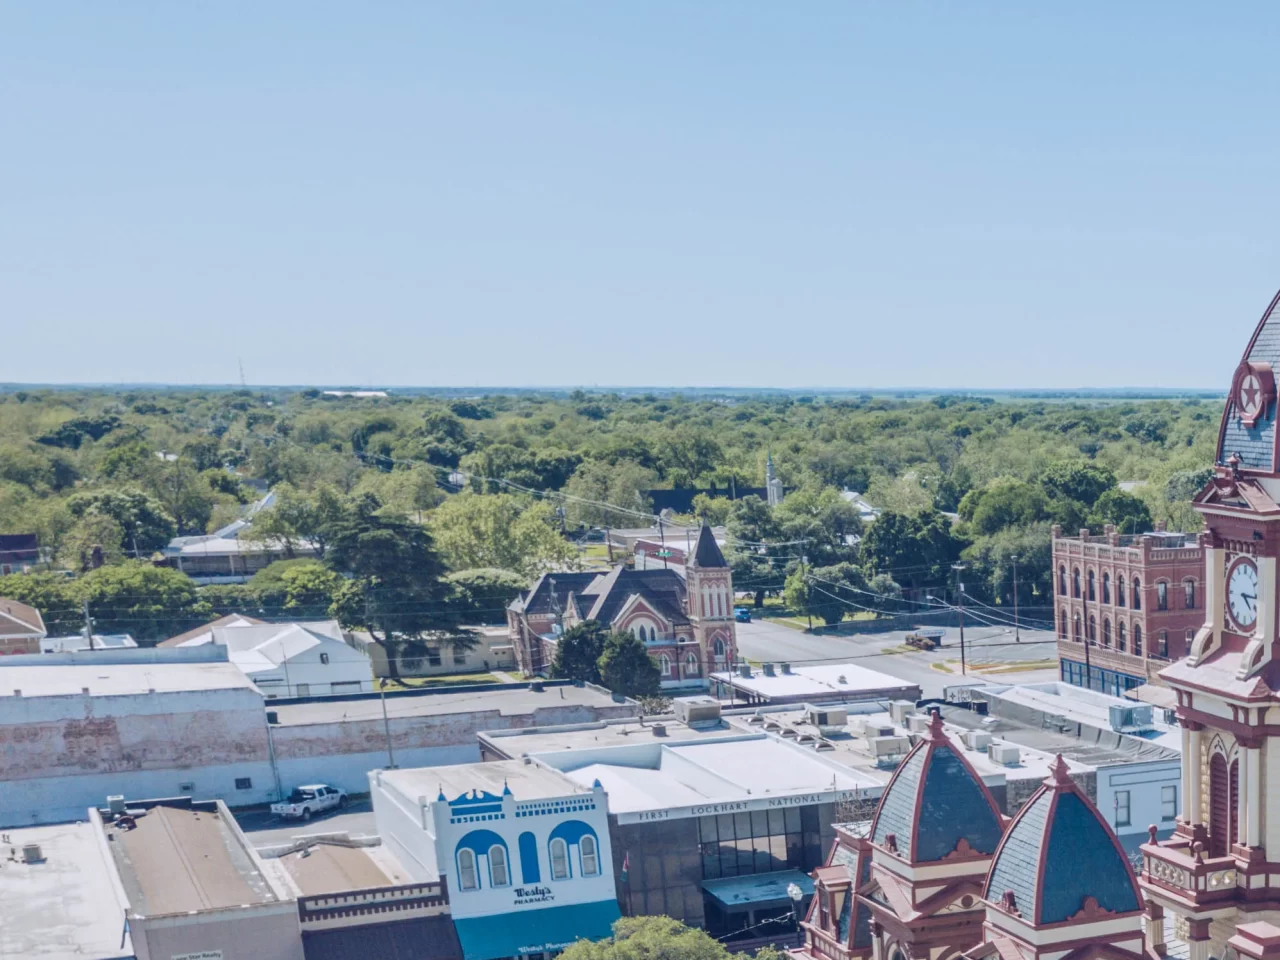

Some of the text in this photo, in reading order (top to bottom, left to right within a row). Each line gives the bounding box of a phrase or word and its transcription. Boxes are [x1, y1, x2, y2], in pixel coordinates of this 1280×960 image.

[639, 810, 669, 820] FIRST
[691, 802, 749, 815] LOCKHART
[768, 794, 821, 807] NATIONAL
[514, 896, 555, 905] PHARMACY
